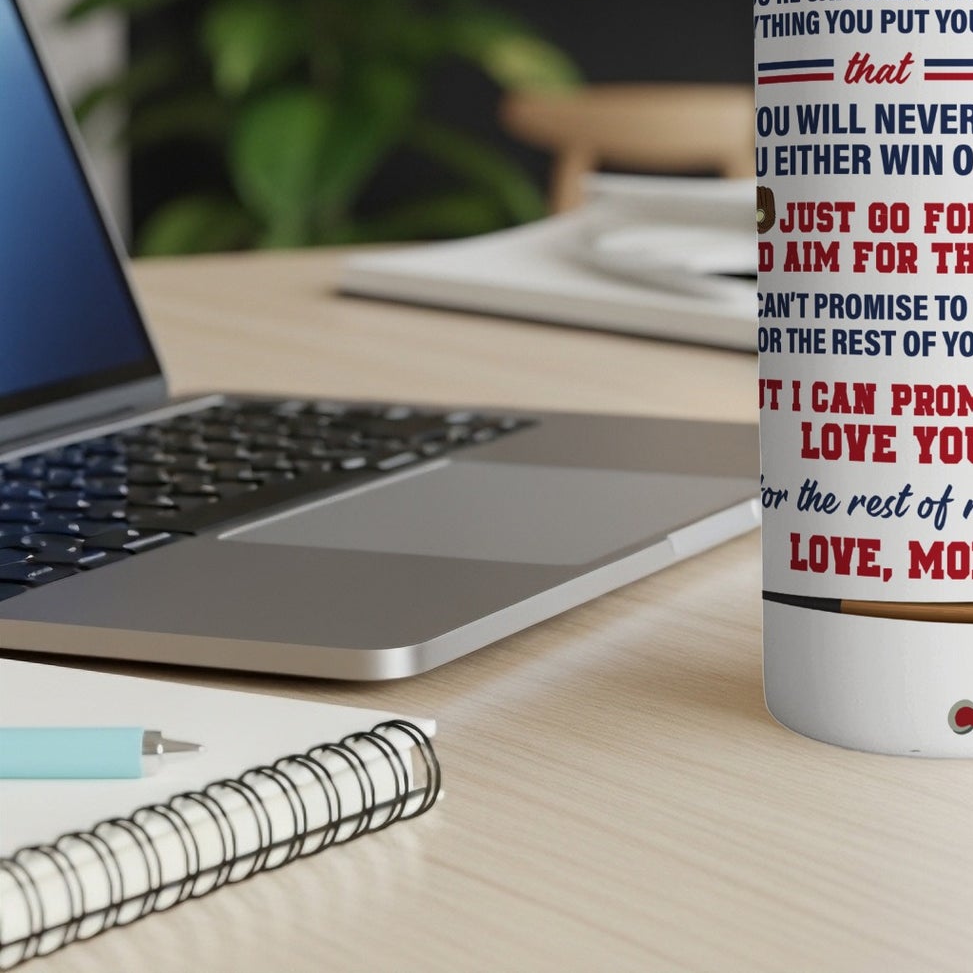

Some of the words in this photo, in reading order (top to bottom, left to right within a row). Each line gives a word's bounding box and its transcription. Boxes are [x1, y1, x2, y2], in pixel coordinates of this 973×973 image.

[755, 11, 819, 38] THING
[825, 10, 872, 33] YOU
[881, 10, 929, 33] PUT
[844, 52, 914, 84] that
[756, 106, 789, 137] OU
[796, 104, 866, 135] WILL
[775, 144, 870, 176] EITHER
[880, 145, 942, 175] WIN
[780, 201, 856, 233] JUST
[868, 202, 910, 234] GO
[784, 241, 840, 272] AIM
[852, 241, 918, 274] FOR
[815, 294, 927, 320] PROMISE
[935, 296, 967, 321] TO
[758, 327, 781, 355] OR
[786, 328, 826, 354] THE
[833, 329, 896, 355] REST
[904, 331, 936, 356] OF
[792, 381, 800, 411] I
[812, 381, 877, 415] CAN
[801, 422, 897, 463] LOVE
[761, 474, 788, 509] or
[797, 478, 841, 514] the
[847, 484, 913, 518] rest
[918, 485, 954, 530] of
[790, 533, 893, 582] LOVE,
